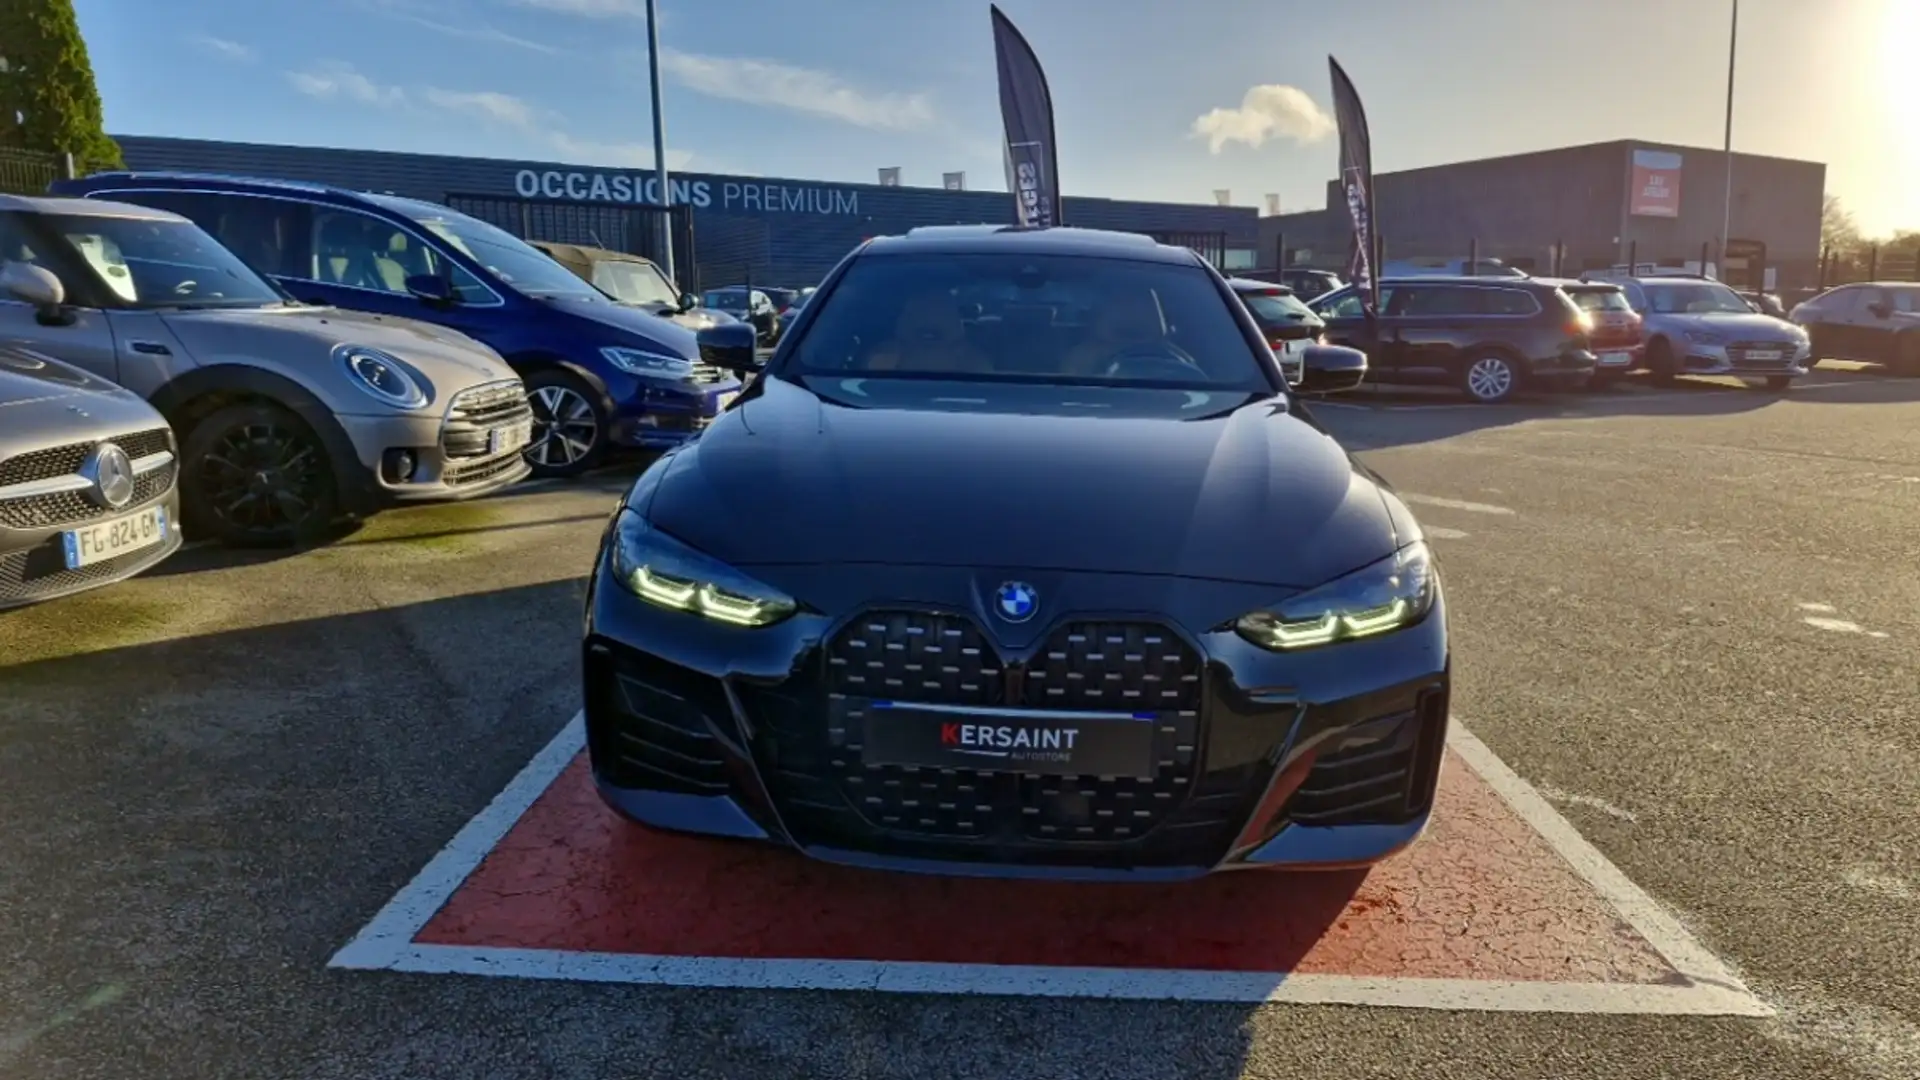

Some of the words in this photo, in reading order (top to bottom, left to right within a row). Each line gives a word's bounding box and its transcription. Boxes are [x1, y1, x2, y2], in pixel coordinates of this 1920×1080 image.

[515, 169, 712, 207] OCCASIONS
[723, 183, 858, 214] PREMIUM
[942, 723, 1079, 749] KERSAINT
[1011, 751, 1073, 763] AUTOSTORE
